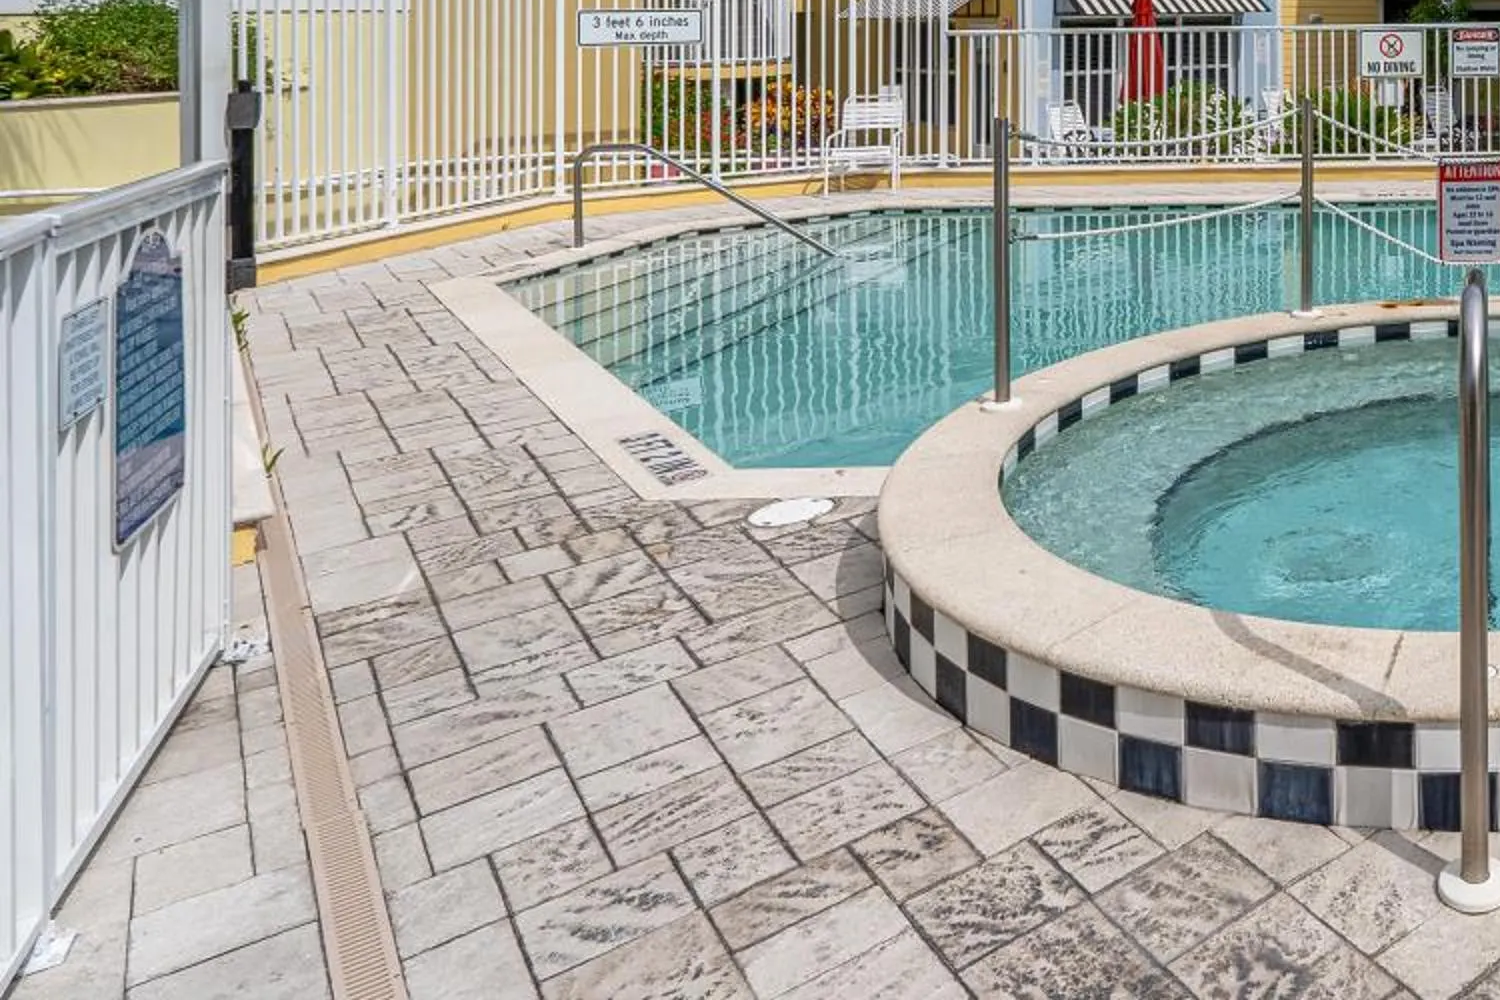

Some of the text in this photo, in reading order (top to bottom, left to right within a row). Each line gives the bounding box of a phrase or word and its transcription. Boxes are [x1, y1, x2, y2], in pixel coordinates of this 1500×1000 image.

[592, 15, 689, 29] 3 feet 6 inches
[639, 31, 668, 41] depth
[1367, 61, 1416, 74] NO DIVING
